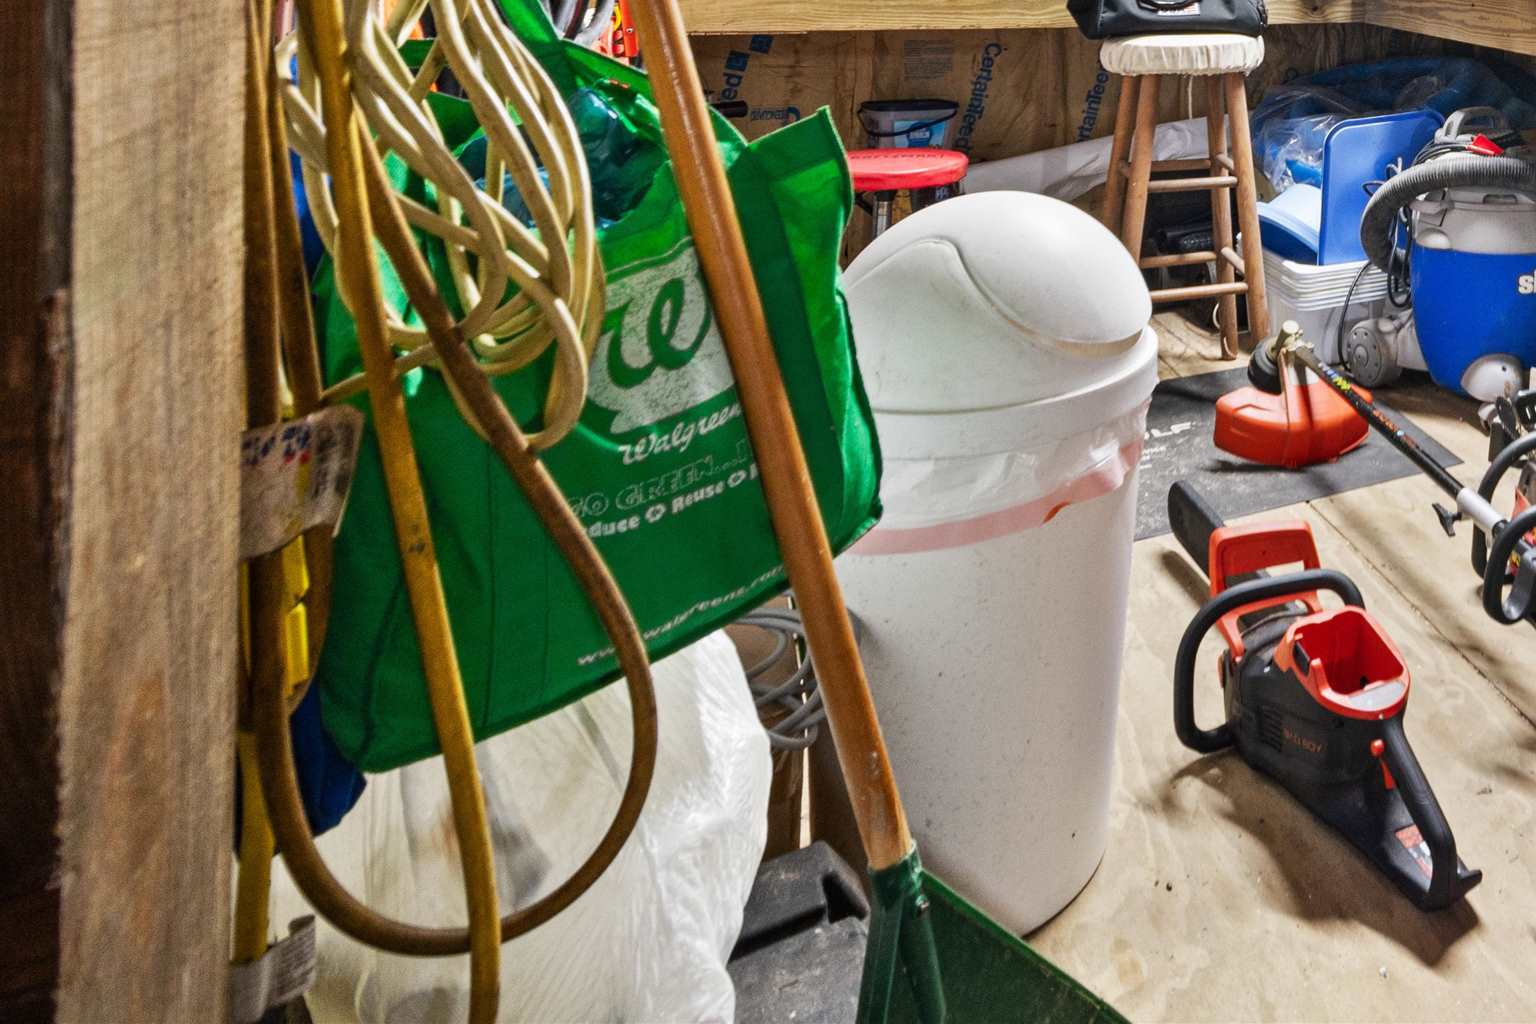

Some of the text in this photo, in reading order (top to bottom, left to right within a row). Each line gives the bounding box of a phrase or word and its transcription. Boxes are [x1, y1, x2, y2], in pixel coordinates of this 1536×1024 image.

[1077, 71, 1110, 143] rtainTee
[617, 403, 742, 465] Walgreen
[588, 481, 723, 538] duce Reuse
